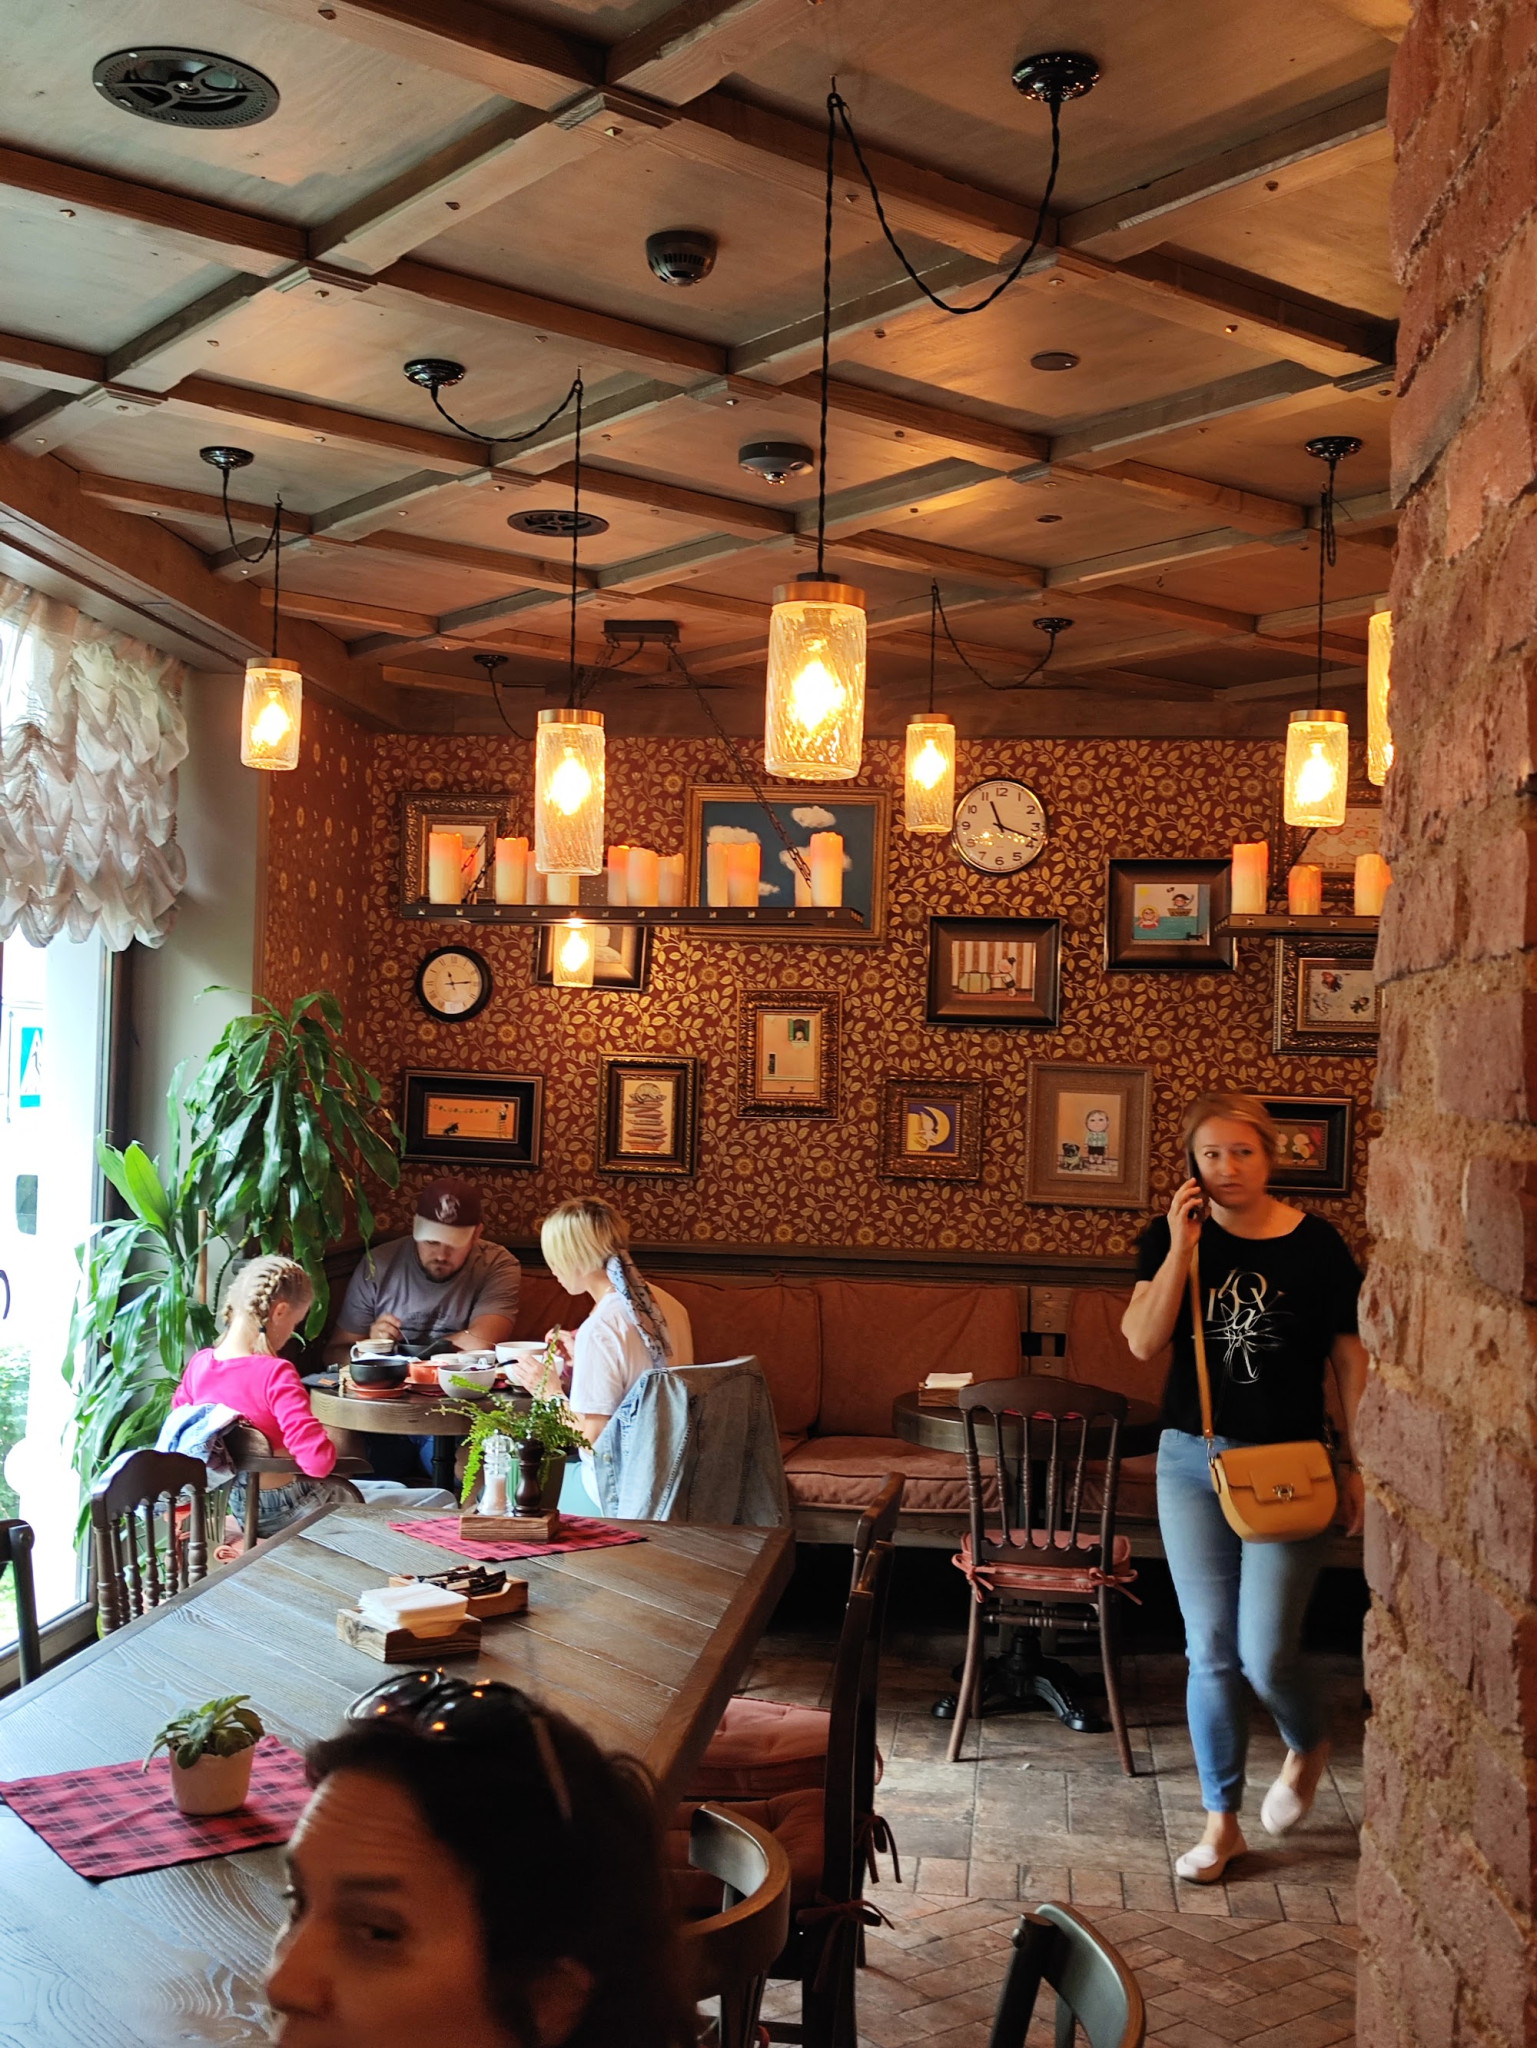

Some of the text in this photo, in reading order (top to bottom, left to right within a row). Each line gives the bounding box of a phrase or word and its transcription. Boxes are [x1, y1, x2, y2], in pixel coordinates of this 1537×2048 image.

[981, 792, 989, 801] 11
[996, 787, 1008, 797] 12
[967, 805, 977, 814] 10
[1026, 805, 1035, 814] 2
[961, 821, 971, 830] 9
[1031, 822, 1040, 832] 3
[1025, 839, 1034, 849] 4
[978, 851, 987, 860] 7
[1012, 852, 1022, 861] 5
[995, 856, 1004, 866] 6
